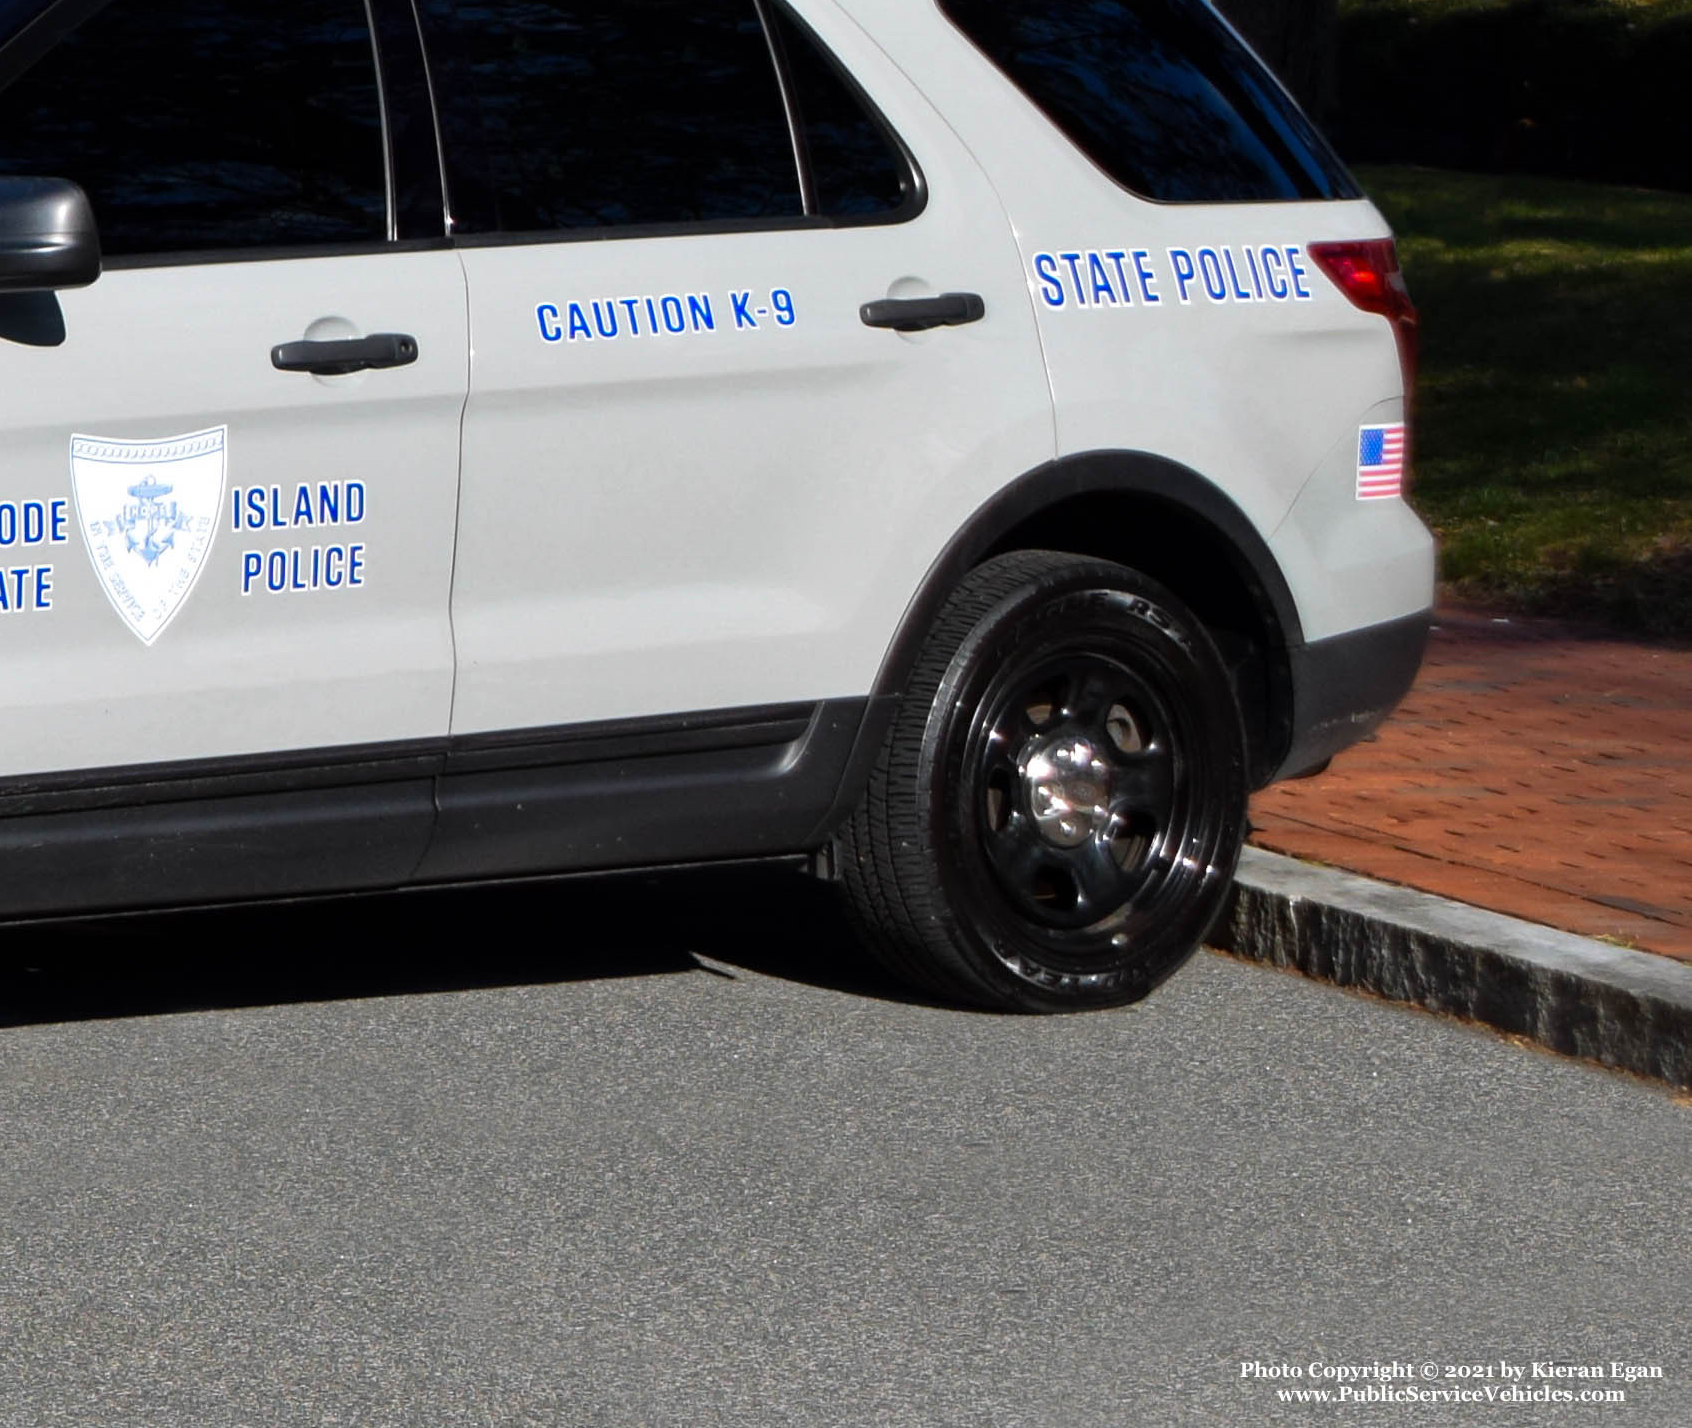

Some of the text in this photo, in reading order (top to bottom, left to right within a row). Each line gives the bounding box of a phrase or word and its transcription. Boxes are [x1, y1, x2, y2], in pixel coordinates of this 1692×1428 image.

[1035, 247, 1311, 306] STATE POLICE
[536, 288, 797, 342] CAUTION K-9
[130, 503, 168, 519] HOPE
[233, 482, 365, 529] ISLAND
[244, 545, 363, 591] POLICE
